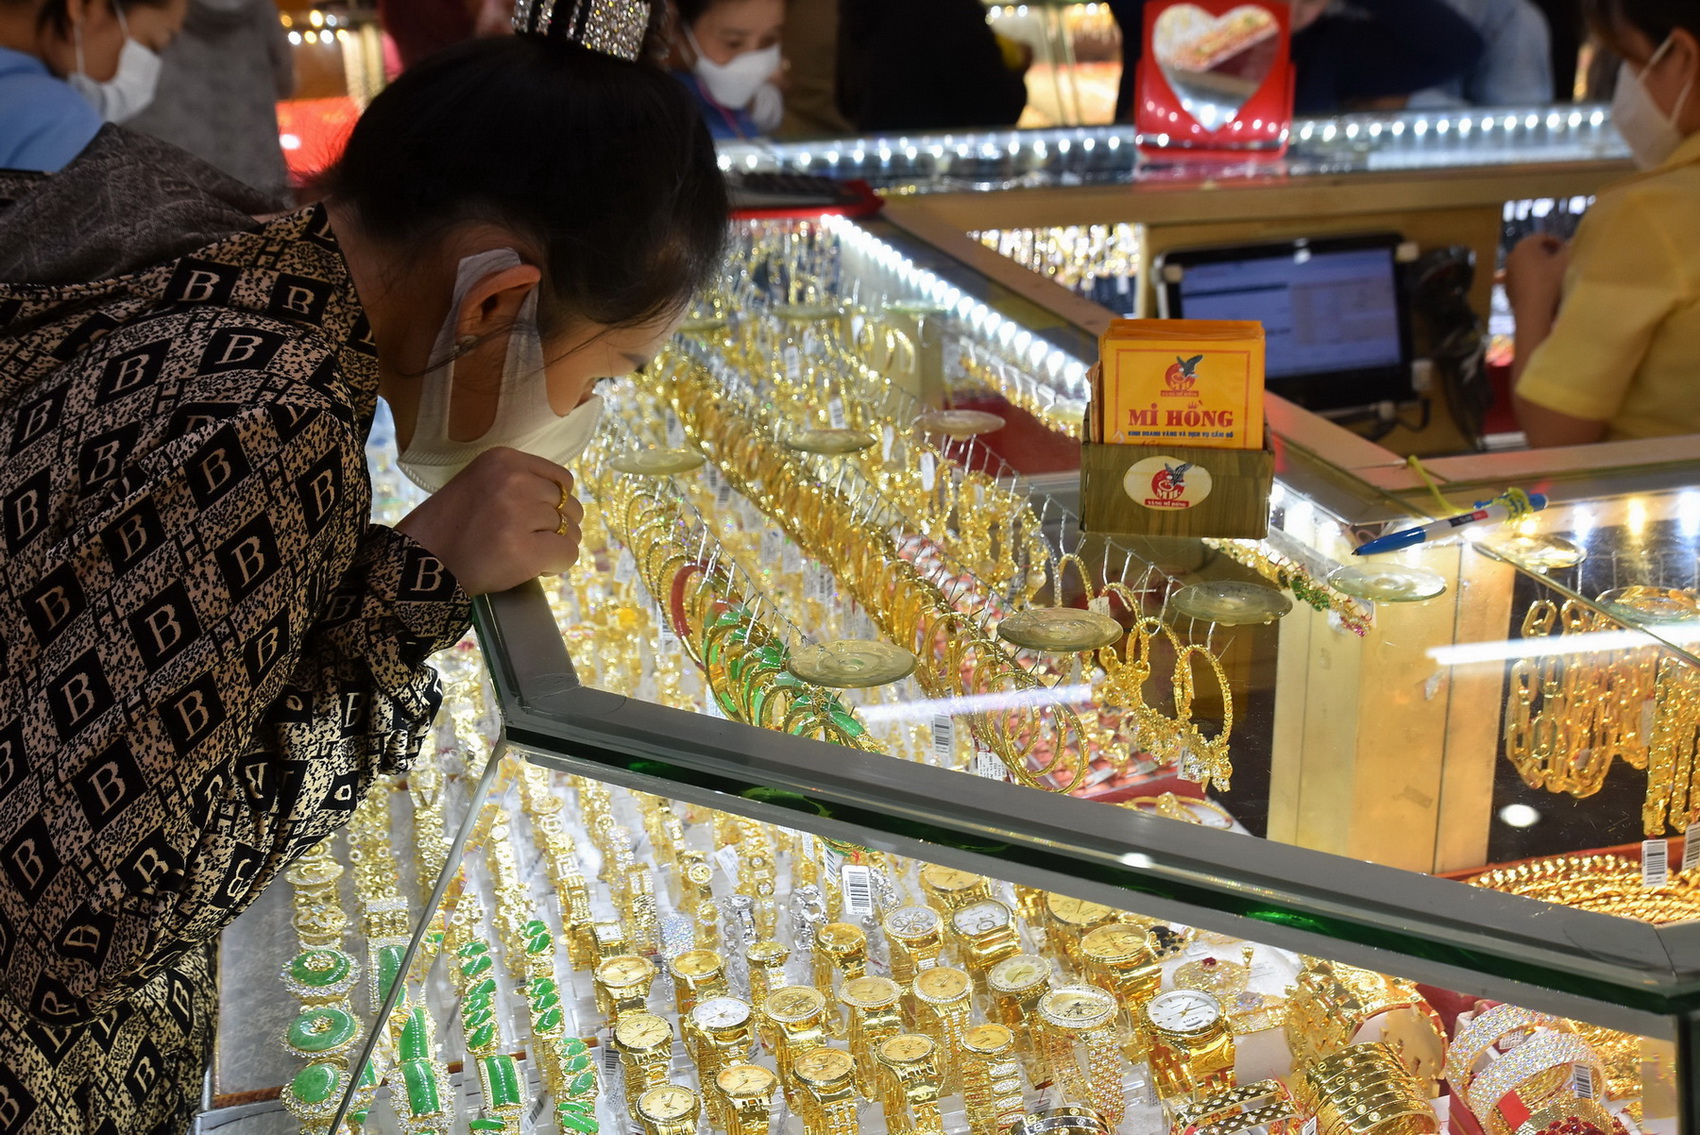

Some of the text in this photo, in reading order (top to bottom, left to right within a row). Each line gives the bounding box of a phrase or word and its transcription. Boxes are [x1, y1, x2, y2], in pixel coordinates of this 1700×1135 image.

[178, 270, 221, 302] B
[215, 334, 263, 365] B
[109, 354, 151, 395] B
[23, 399, 52, 442] B
[86, 440, 121, 485] B
[199, 447, 232, 494] B
[14, 490, 41, 541] B
[309, 469, 336, 520] B
[115, 514, 148, 561] B
[230, 537, 266, 589] B
[415, 557, 445, 591] B
[35, 586, 71, 630] B
[145, 604, 183, 656] B
[256, 626, 279, 673] B
[61, 672, 96, 728] B
[174, 690, 209, 742] B
[88, 761, 126, 815] B
[12, 838, 44, 889] B
